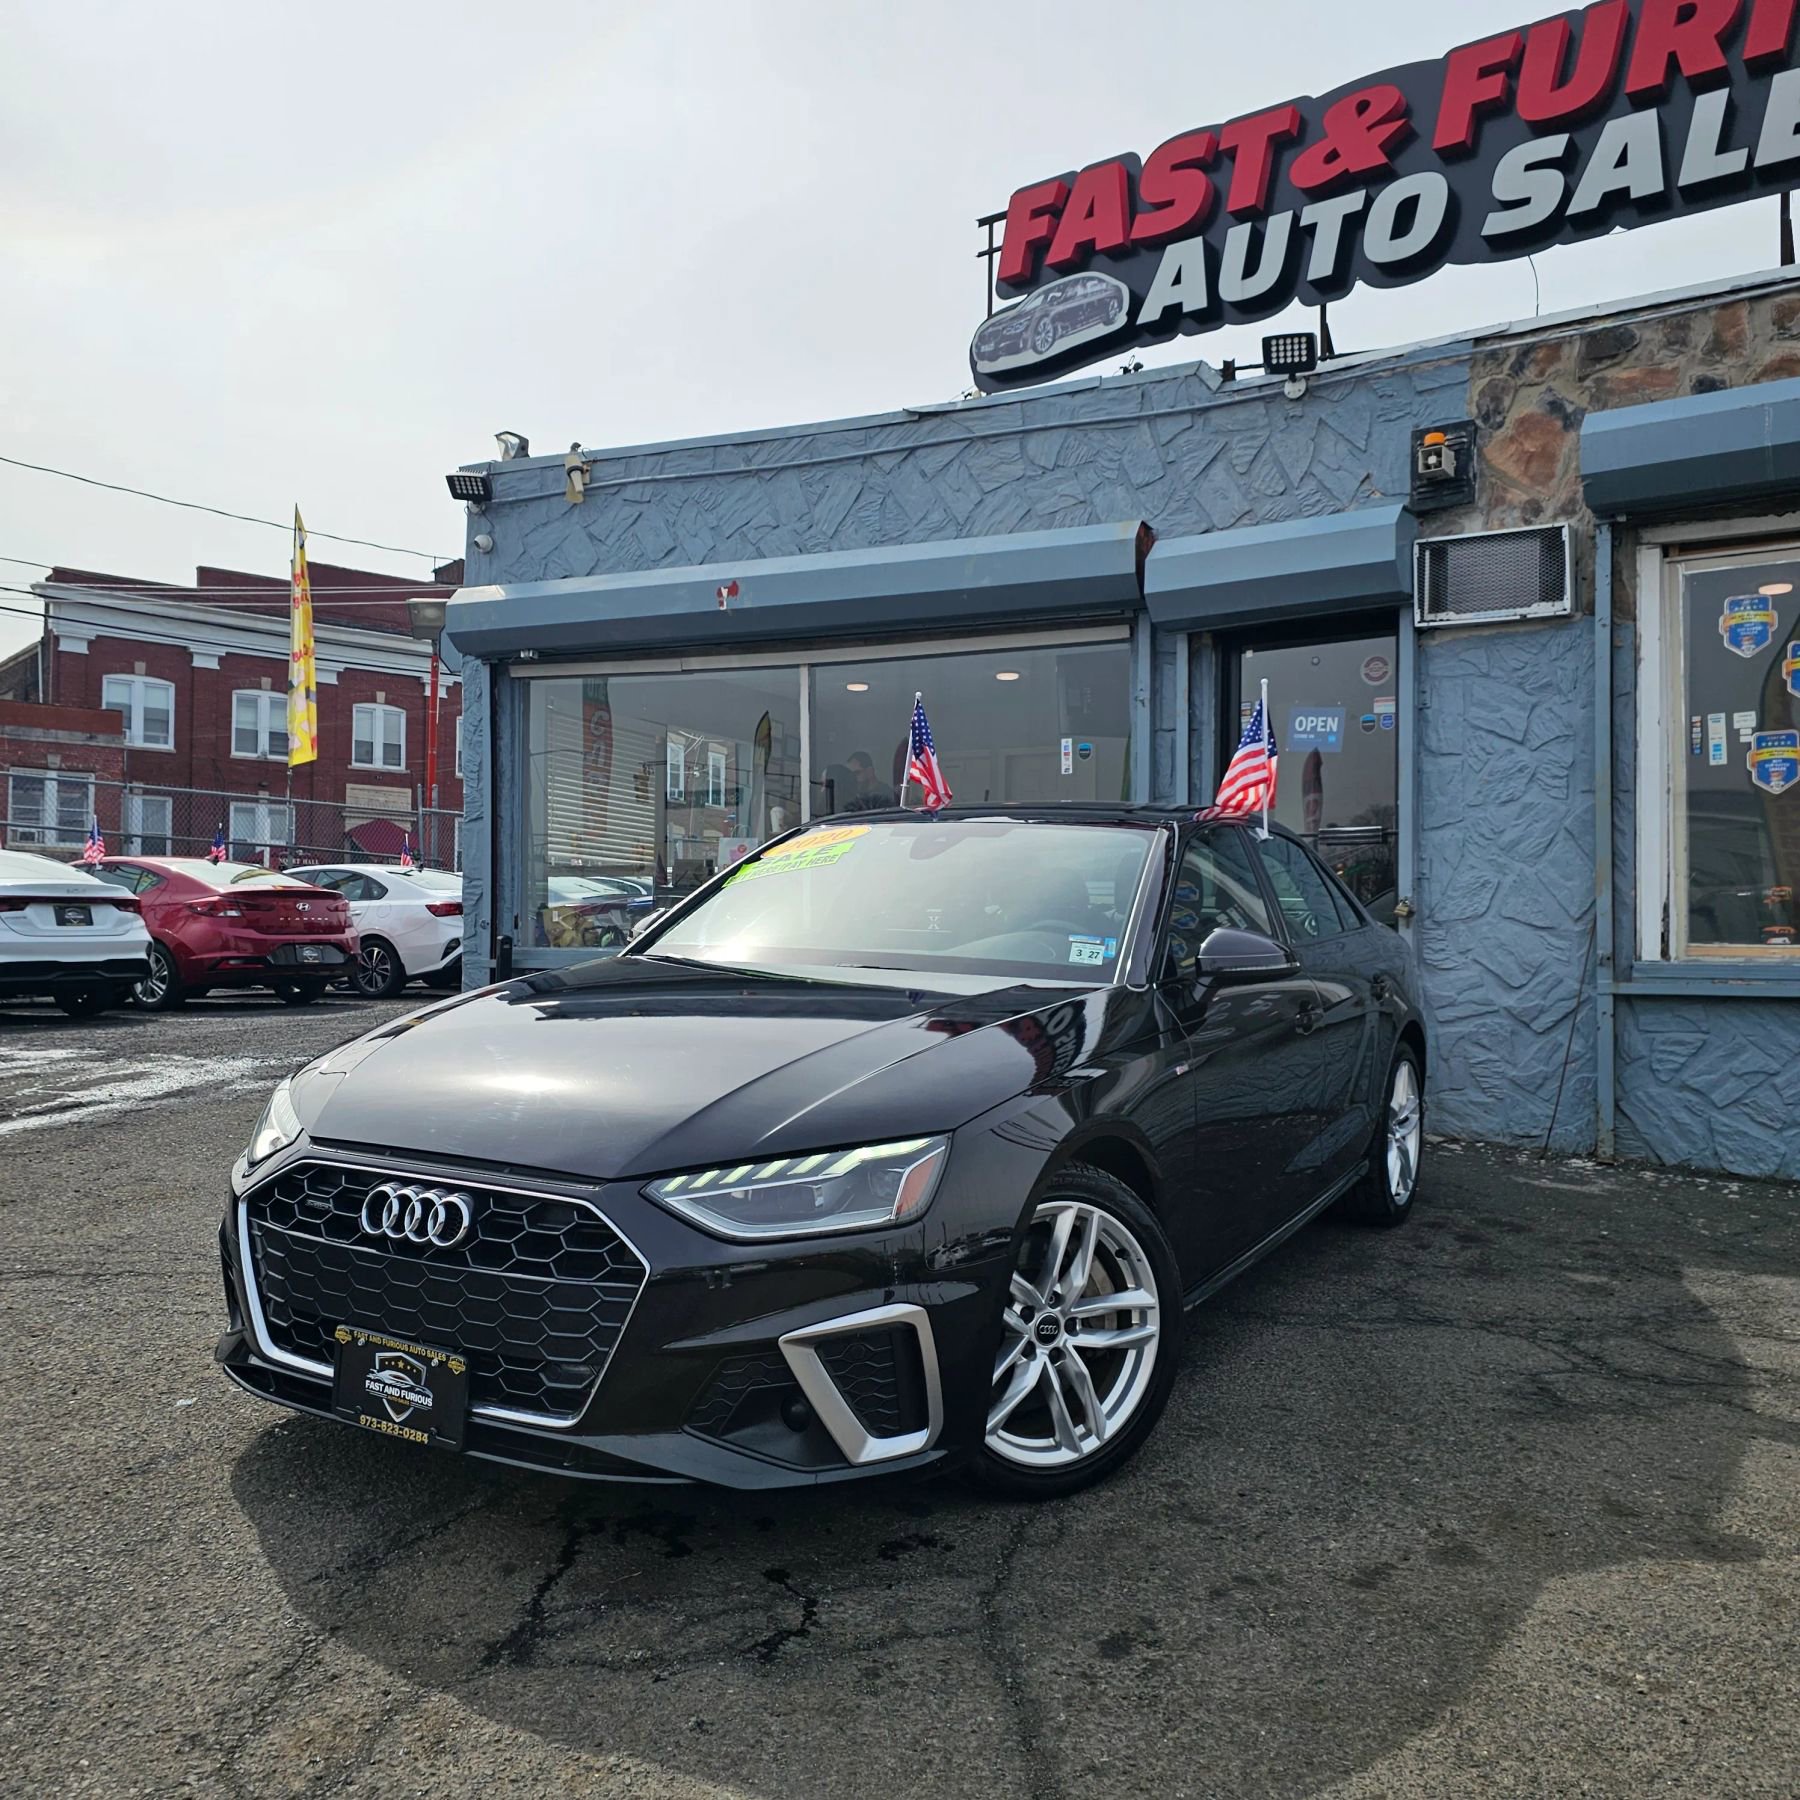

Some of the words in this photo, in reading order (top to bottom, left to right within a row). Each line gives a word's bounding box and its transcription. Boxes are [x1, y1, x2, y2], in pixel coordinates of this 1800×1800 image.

[1001, 104, 1300, 284] FAST
[1289, 85, 1410, 197] &
[1136, 171, 1449, 326] AUTO
[1294, 716, 1339, 732] OPEN
[806, 855, 837, 865] HERE
[1076, 949, 1083, 957] 3
[1088, 950, 1100, 960] 27
[353, 1330, 369, 1341] FAST
[369, 1335, 382, 1345] AND
[383, 1338, 409, 1352] FURIOUS
[409, 1345, 426, 1357] AUTO
[426, 1349, 447, 1362] SALES
[365, 1379, 384, 1392] FAST
[384, 1385, 401, 1397] AND
[401, 1390, 433, 1407] FURIOUS
[359, 1414, 429, 1445] 973-623-0284
